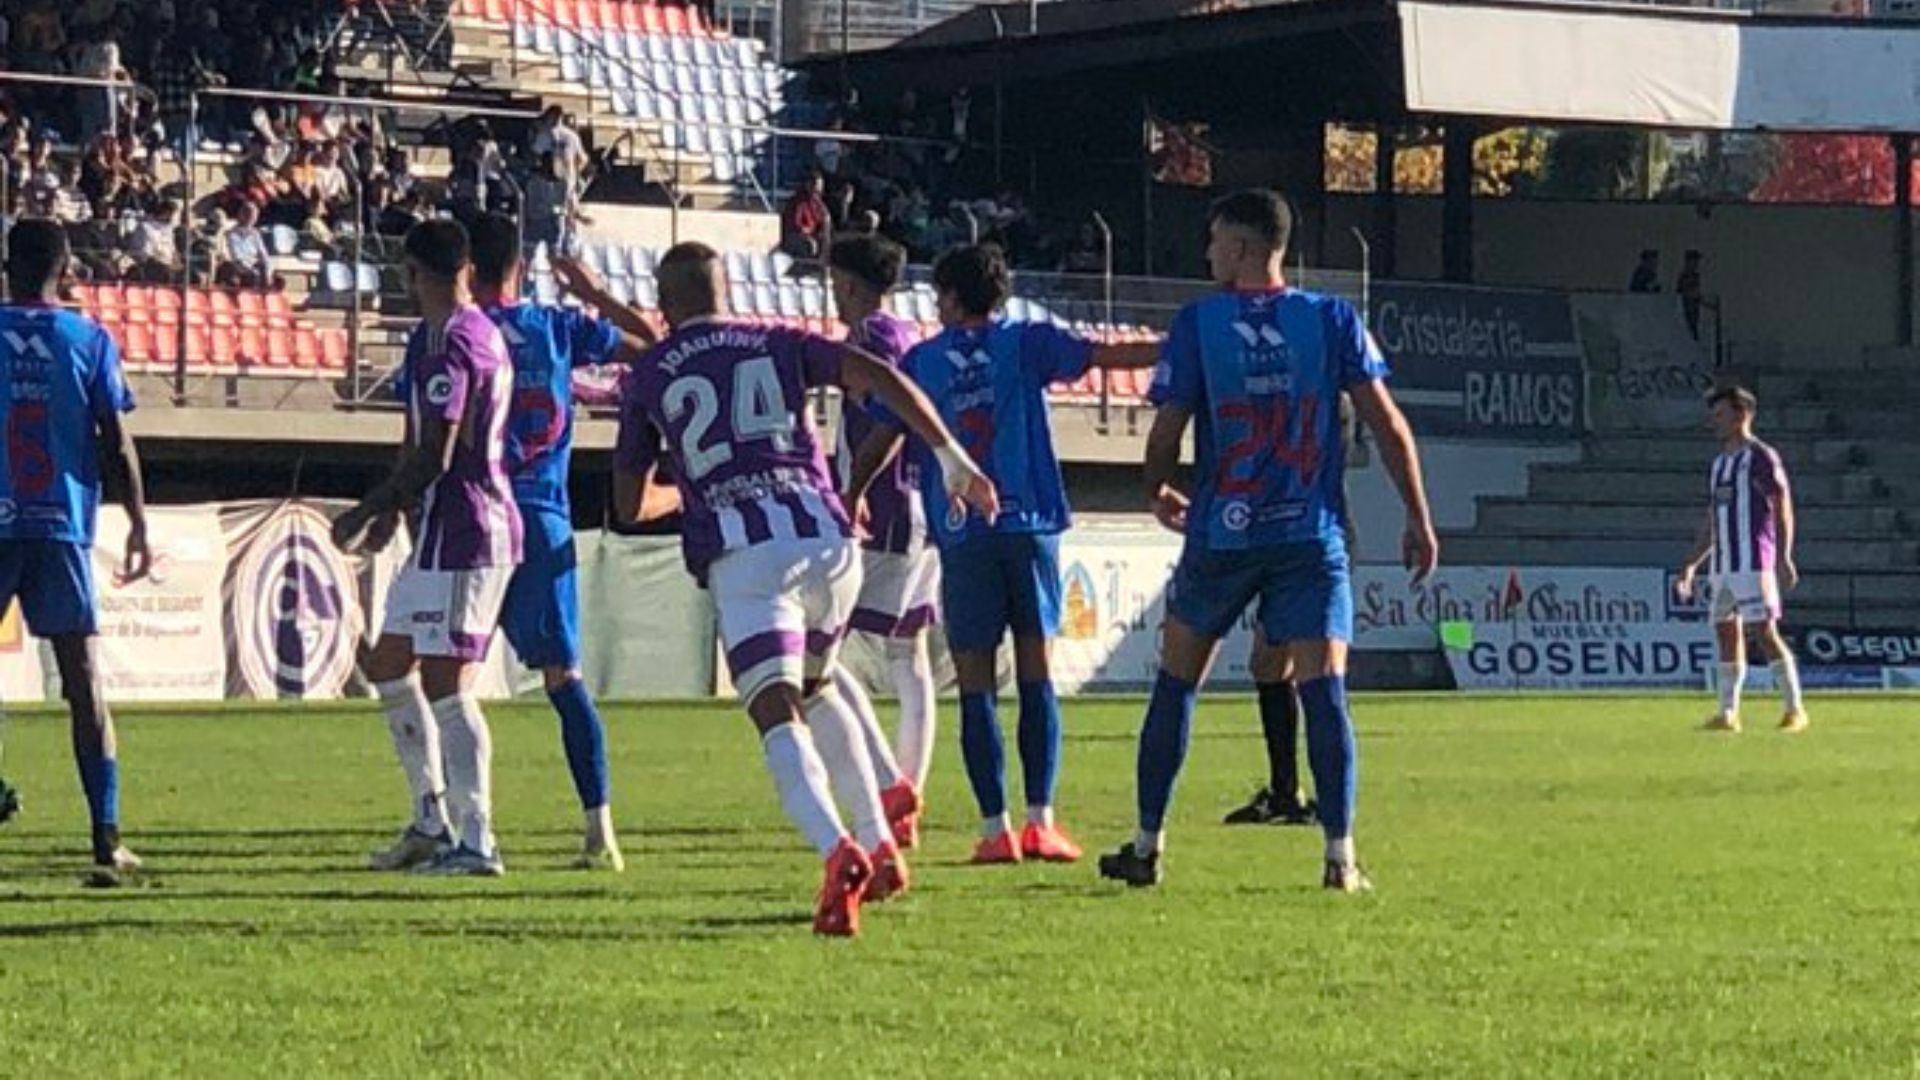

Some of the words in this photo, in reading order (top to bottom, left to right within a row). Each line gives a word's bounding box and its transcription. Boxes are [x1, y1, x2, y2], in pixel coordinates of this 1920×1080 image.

[661, 357, 796, 481] 24
[1465, 372, 1574, 427] RAMOS
[6, 403, 55, 494] 6
[1217, 392, 1320, 496] 24
[1355, 580, 1406, 633] La
[1527, 581, 1650, 624] Galicia
[1532, 624, 1629, 640] MUEBLES
[1467, 640, 1713, 675] GOSENDE
